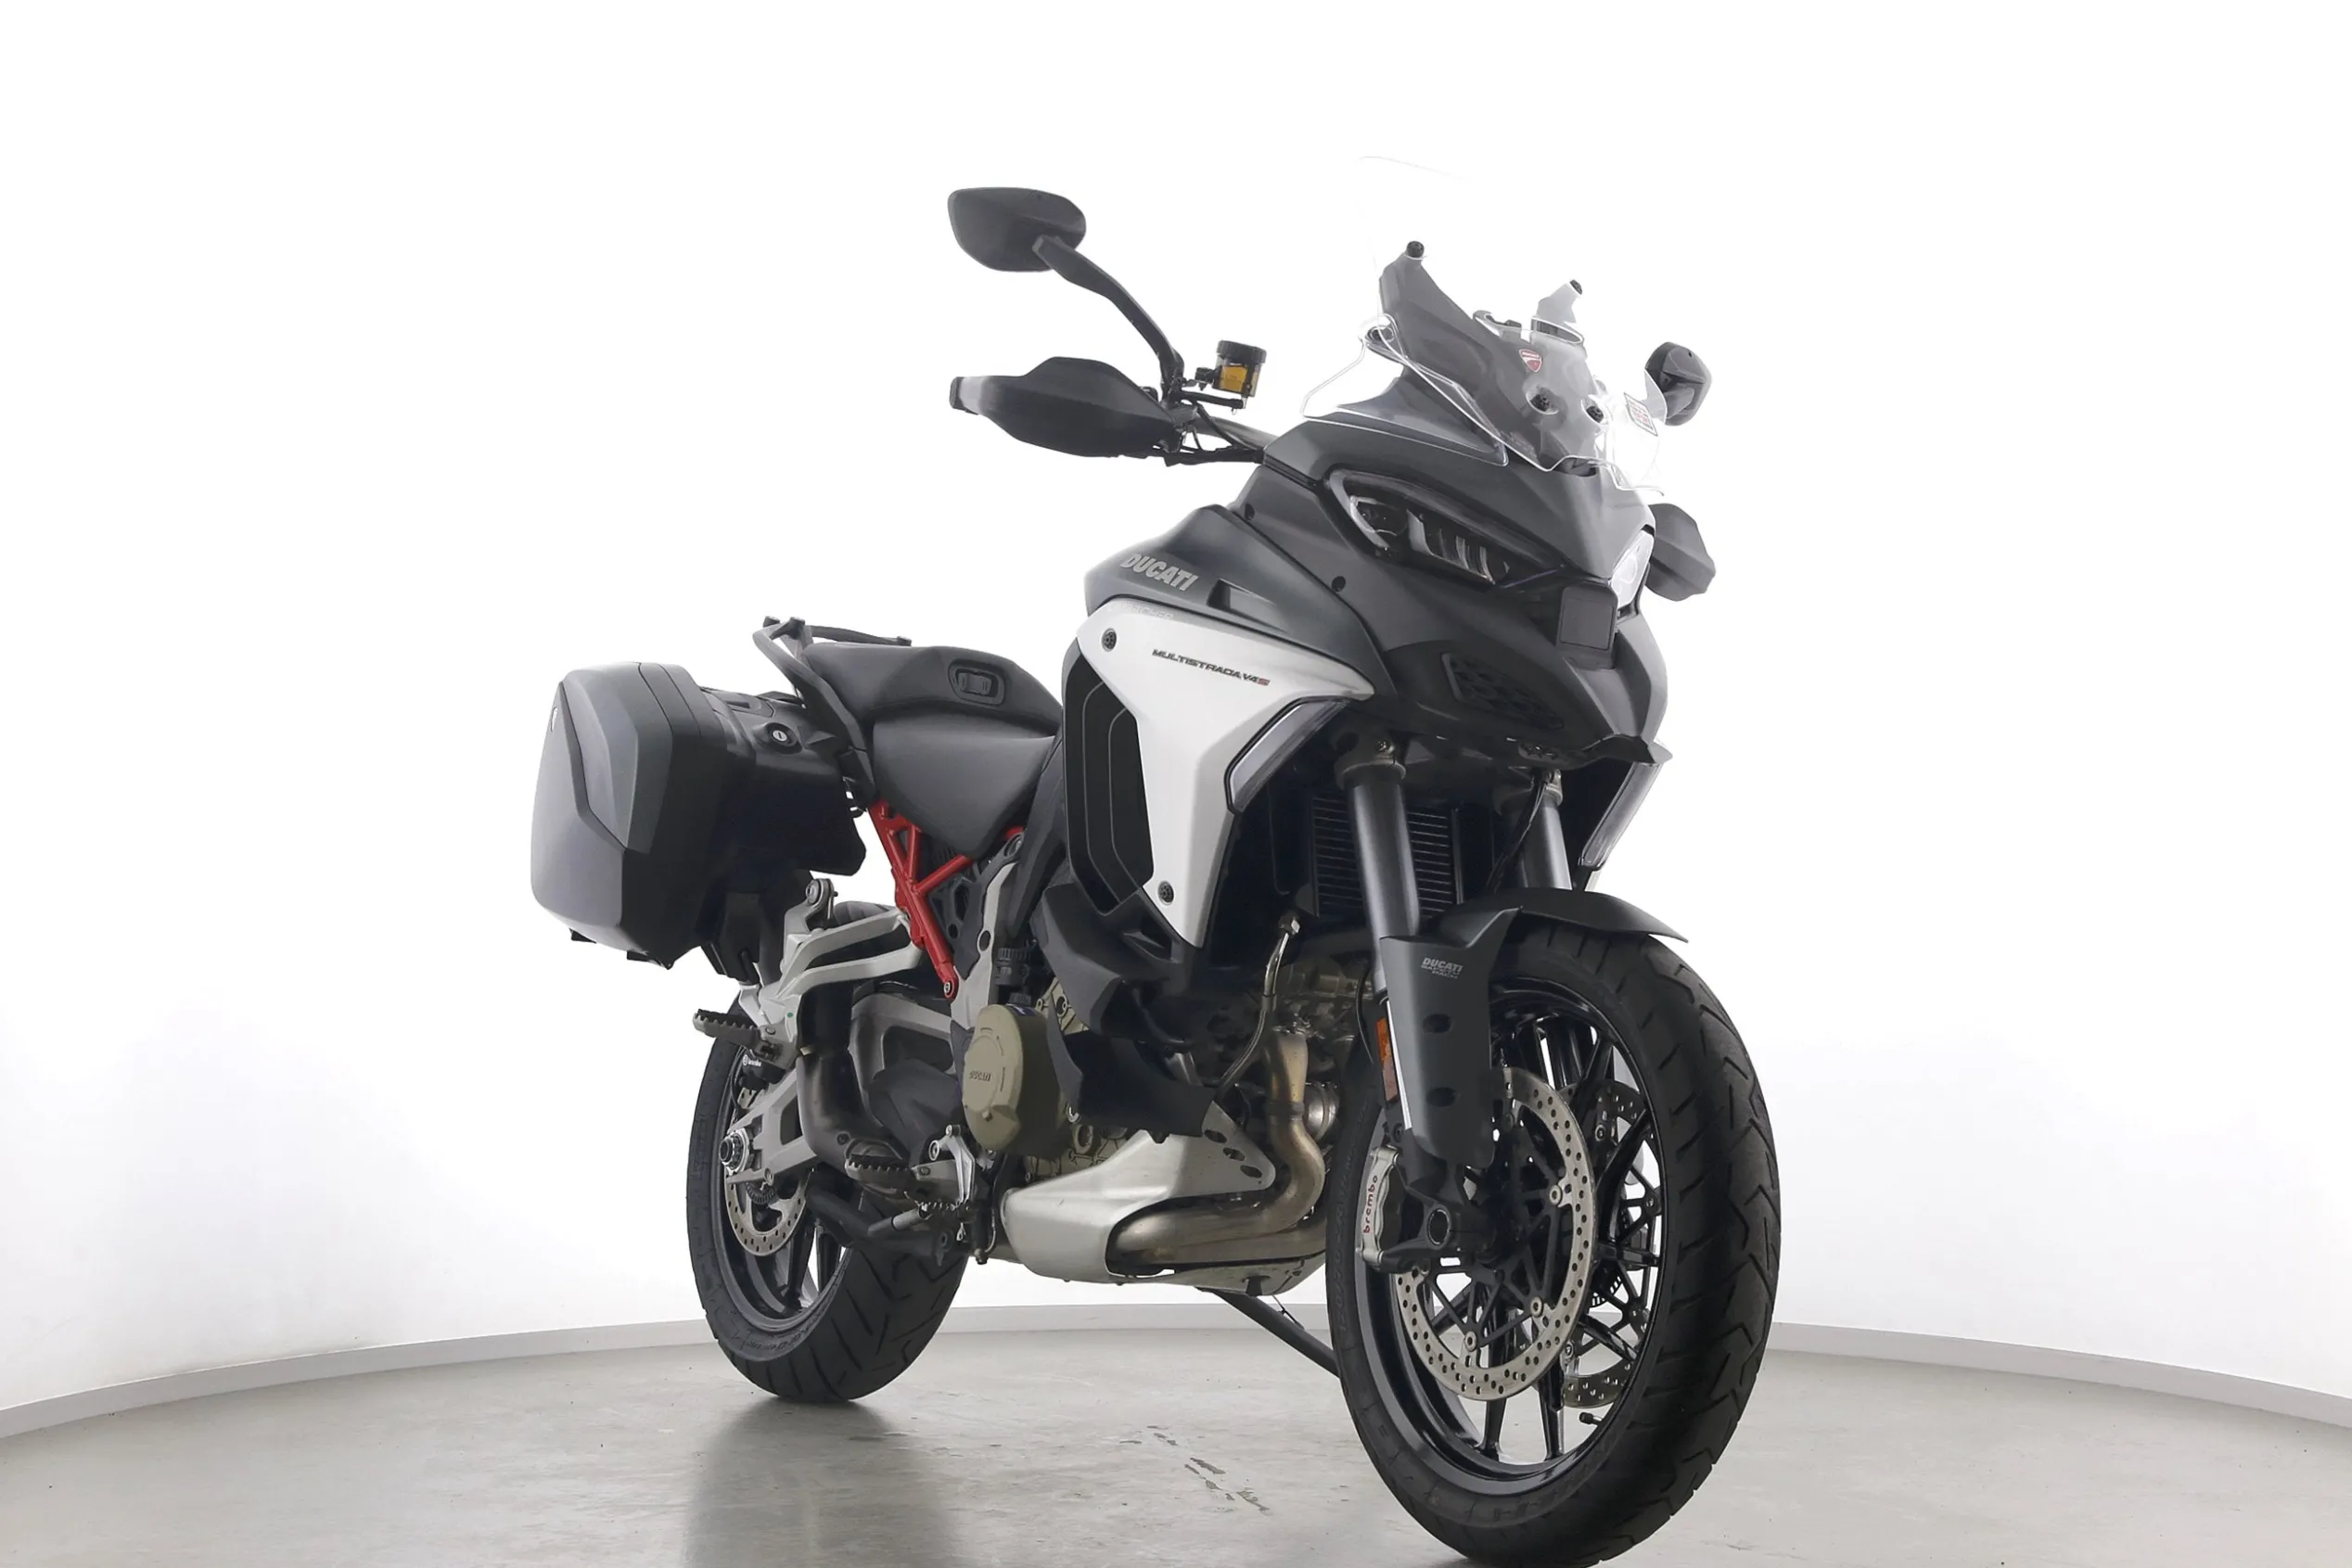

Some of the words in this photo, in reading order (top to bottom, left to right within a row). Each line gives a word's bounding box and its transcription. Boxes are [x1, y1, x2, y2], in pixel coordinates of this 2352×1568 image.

[1119, 554, 1199, 591] DUCATI
[1152, 649, 1242, 680] MULTISTRADA
[1422, 957, 1464, 973] DUCATI
[1363, 1175, 1378, 1233] brembo
